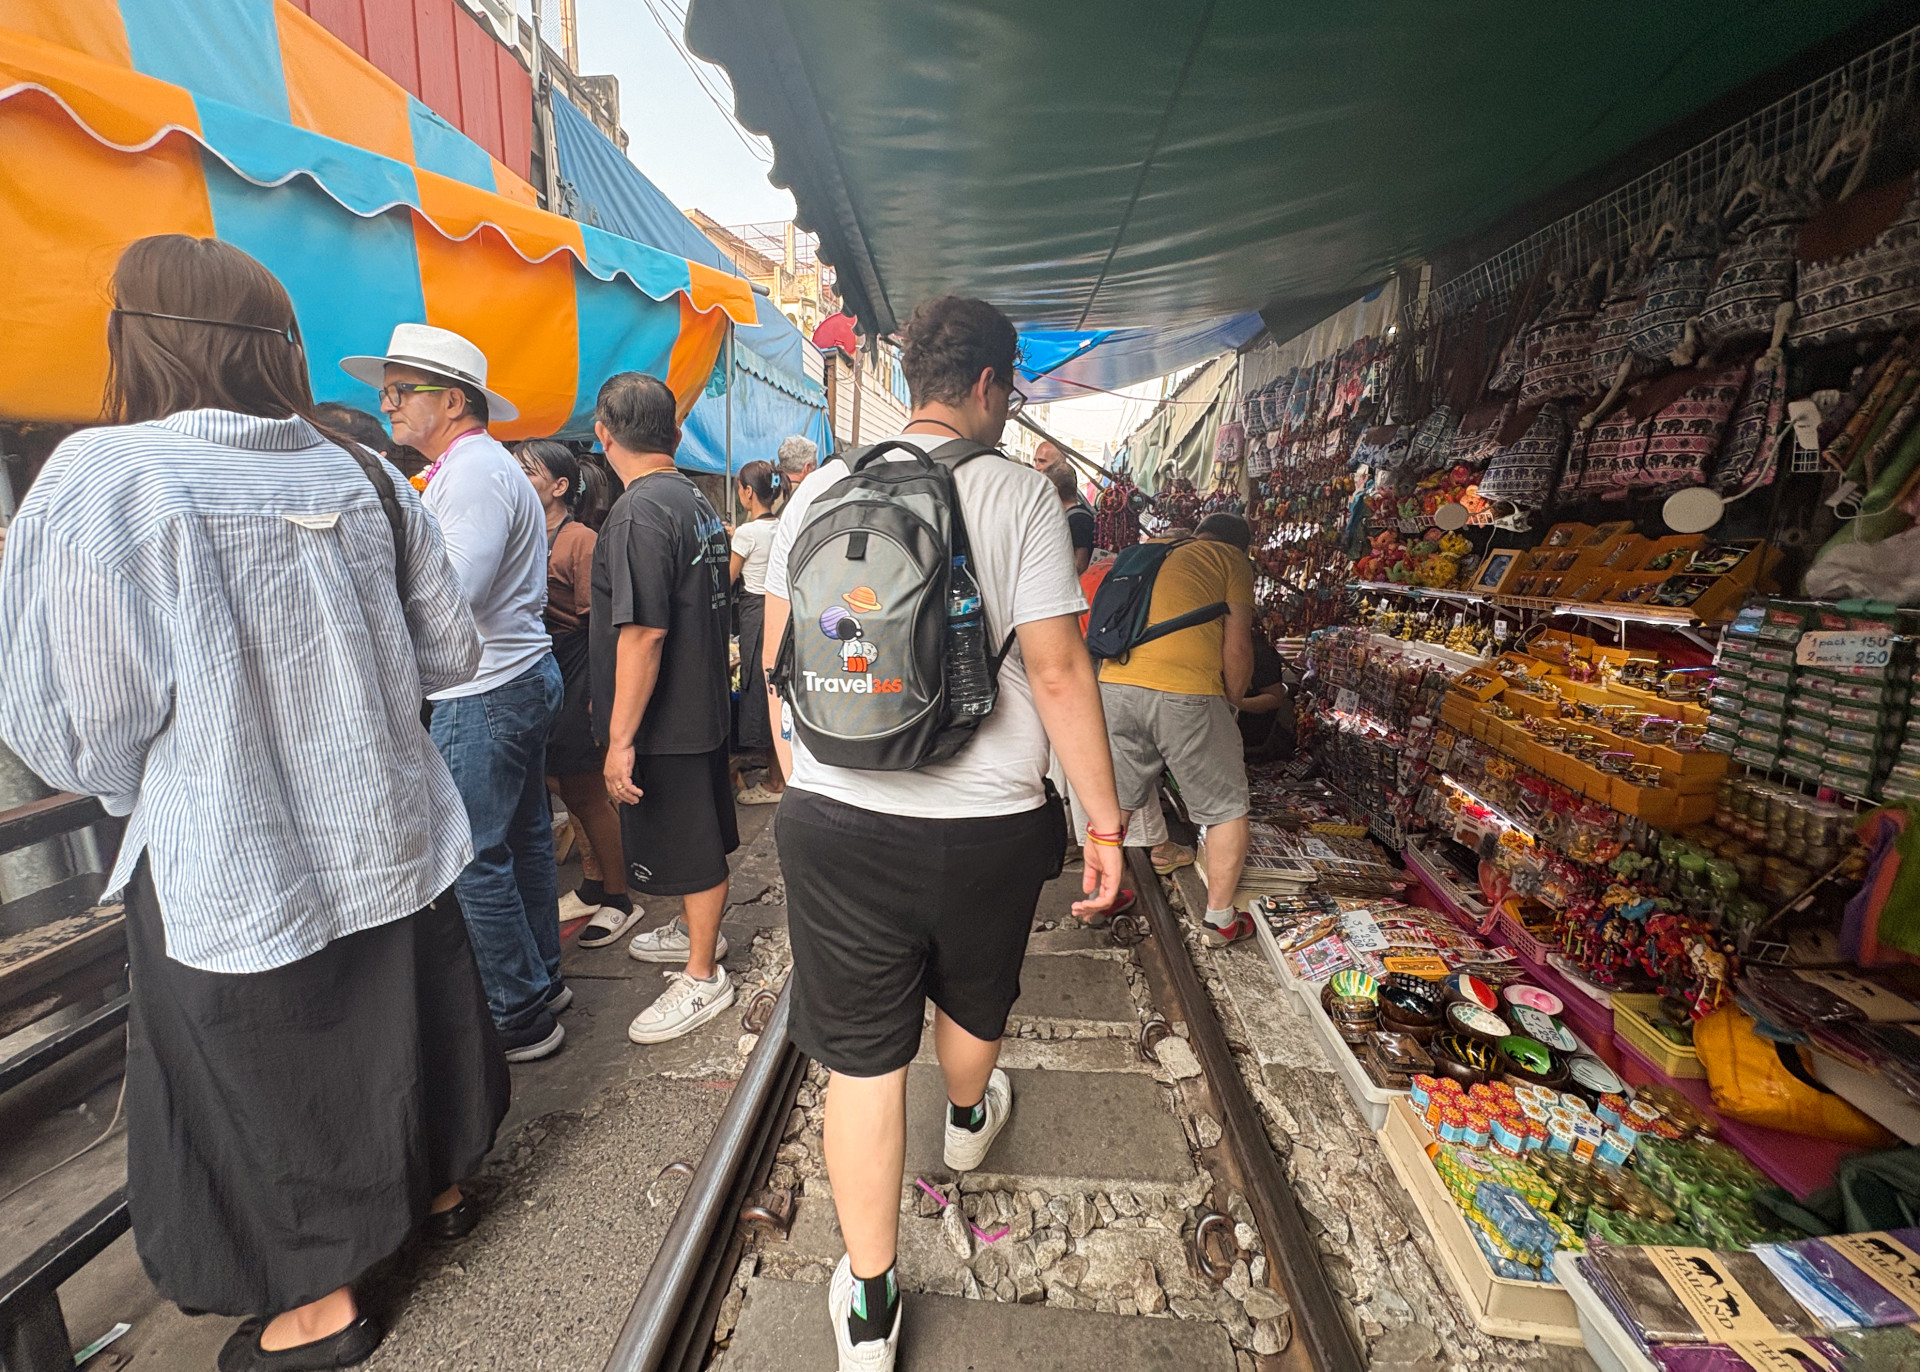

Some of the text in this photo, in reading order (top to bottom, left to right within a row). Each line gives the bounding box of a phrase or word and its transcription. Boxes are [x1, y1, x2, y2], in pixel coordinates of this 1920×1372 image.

[1811, 637, 1818, 647] 1
[1818, 638, 1846, 648] pack
[1860, 636, 1887, 648] 150
[1806, 651, 1816, 662] 2
[1815, 653, 1842, 663] pack
[1855, 650, 1888, 664] 250
[802, 670, 903, 694] Travel365
[1841, 1234, 1920, 1294] THAILAN
[1664, 1247, 1734, 1330] THAILAND
